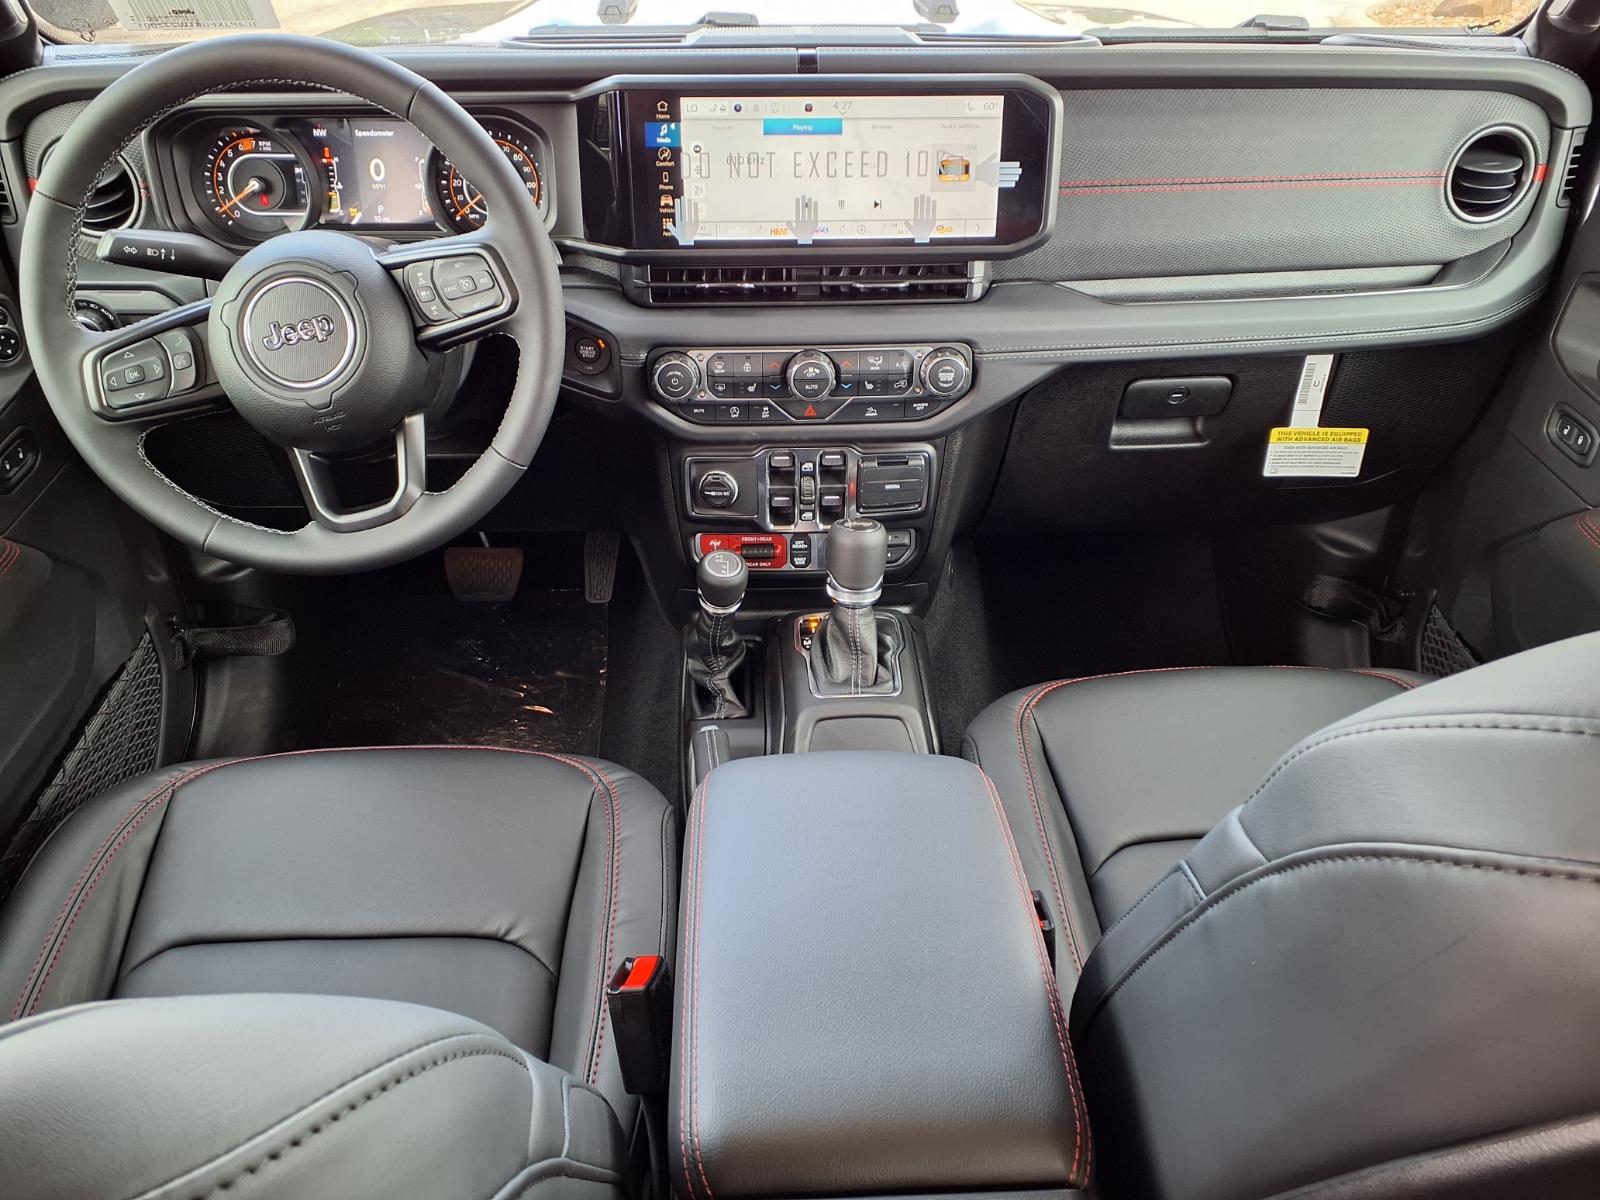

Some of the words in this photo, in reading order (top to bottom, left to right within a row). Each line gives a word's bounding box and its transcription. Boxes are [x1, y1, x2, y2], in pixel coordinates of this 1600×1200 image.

[687, 104, 698, 112] LO
[833, 101, 852, 110] 4:27
[354, 129, 394, 137] Speedometer
[227, 149, 233, 157] 5
[513, 153, 523, 161] 80
[728, 151, 776, 178] NOT
[793, 151, 888, 178] EXCEED
[369, 158, 385, 181] 0
[217, 172, 223, 180] 3
[219, 186, 225, 194] 2
[234, 209, 240, 218] 0
[100, 308, 114, 320] AUTO
[263, 314, 334, 350] Jeep
[129, 370, 140, 379] OK
